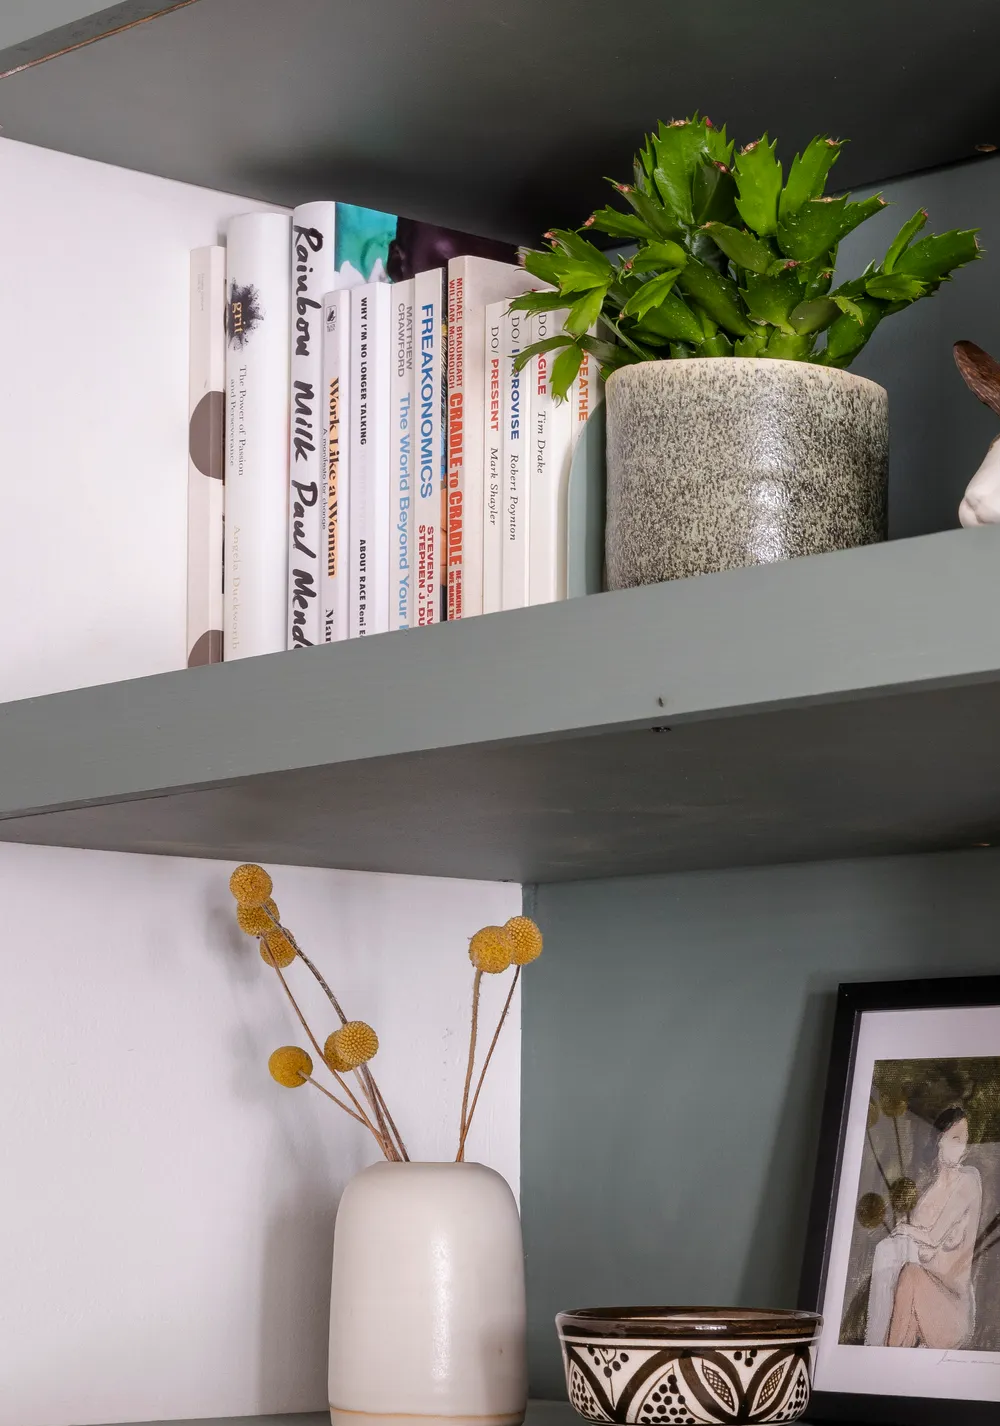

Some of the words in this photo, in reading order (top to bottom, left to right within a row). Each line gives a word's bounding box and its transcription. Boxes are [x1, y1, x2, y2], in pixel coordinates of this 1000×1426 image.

[294, 225, 321, 355] Rainbow
[360, 298, 368, 320] WHY
[232, 302, 246, 334] grit
[512, 317, 520, 344] DO/
[360, 344, 367, 358] NO
[398, 303, 406, 378] CRAWFORD
[491, 327, 499, 354] DO/
[239, 365, 247, 385] The
[491, 359, 499, 431] PRESENT
[238, 389, 246, 421] Power
[293, 381, 316, 461] Milk
[329, 378, 339, 431] Work
[399, 393, 411, 429] The
[421, 303, 433, 498] FREAKONOMICS
[238, 425, 246, 434] of
[449, 393, 463, 467] CRADLE
[538, 411, 546, 436] Tim
[238, 439, 246, 476] Passion
[329, 438, 338, 480] Like
[398, 434, 411, 492] World
[489, 448, 499, 479] Mark
[509, 455, 519, 491] Robert
[537, 440, 546, 474] Drake
[329, 486, 336, 496] a
[488, 484, 498, 525] Shayler
[292, 480, 318, 559] Paul
[328, 500, 338, 576] Woman
[397, 497, 410, 571] Beyond
[449, 492, 462, 566] CRADLE
[508, 496, 518, 541] Poynton
[232, 525, 241, 571] Angela
[359, 539, 367, 573] ABOUT
[418, 525, 426, 588] STEPHEN
[398, 574, 409, 619] Your
[418, 592, 425, 603] J.
[427, 583, 433, 598] D.
[232, 577, 241, 650] Duckworth
